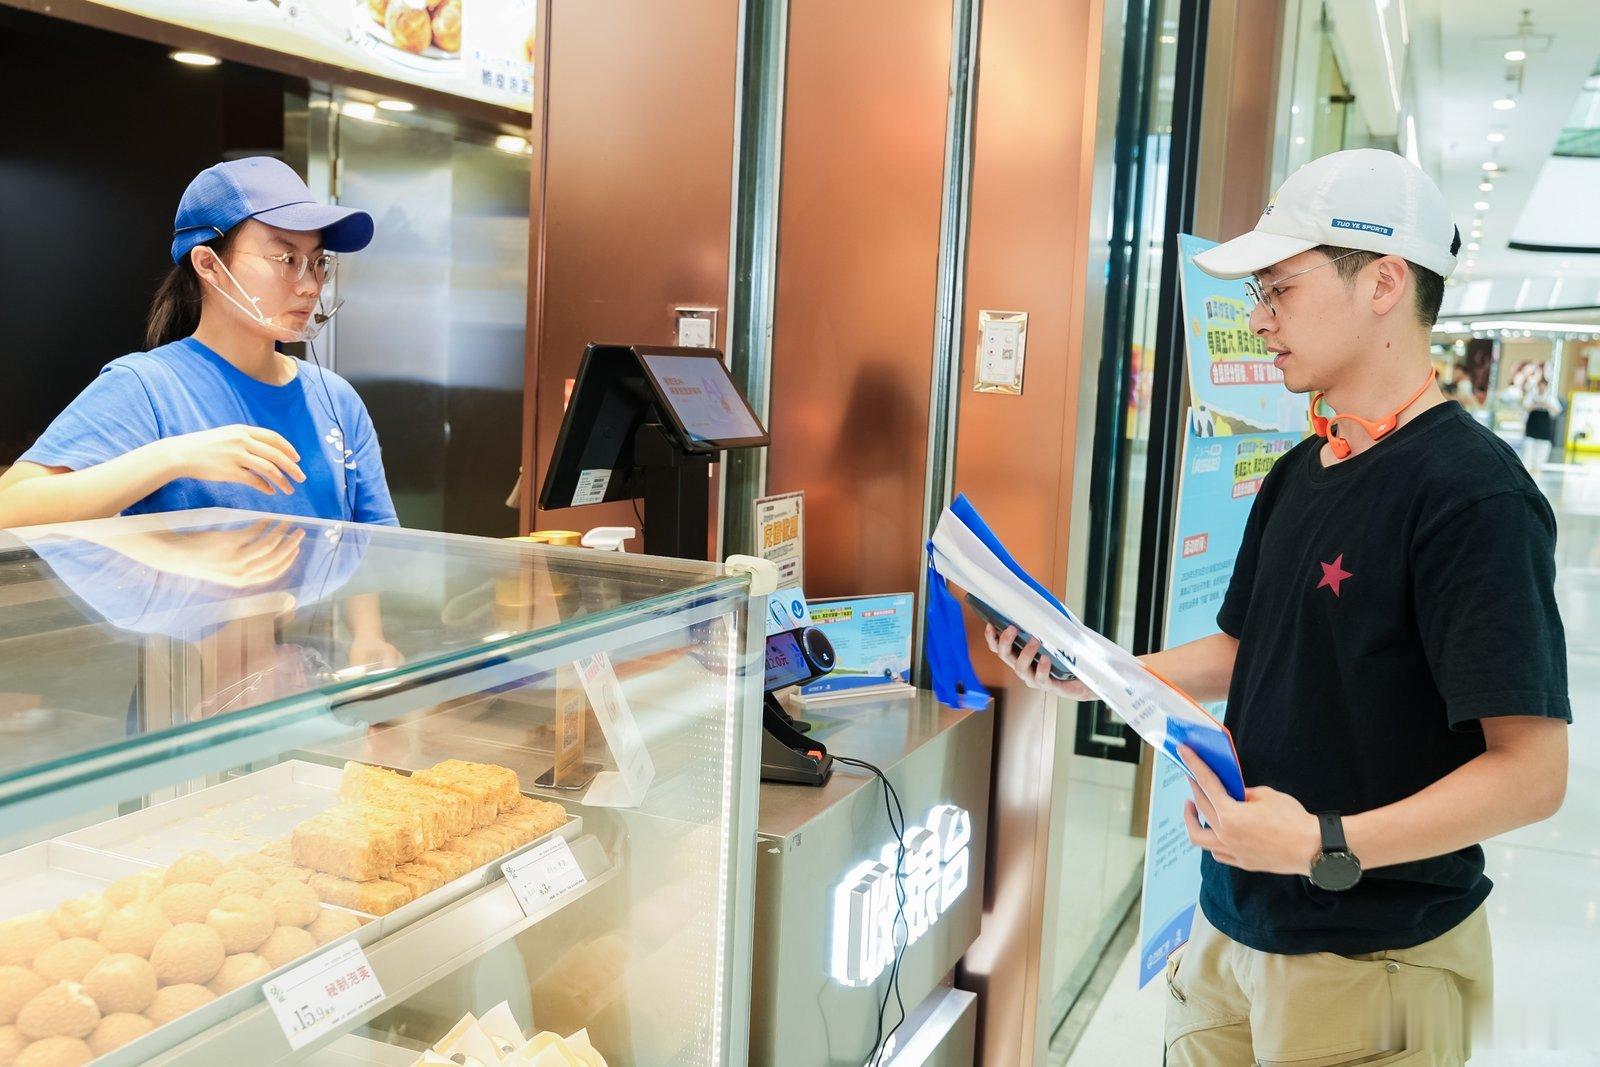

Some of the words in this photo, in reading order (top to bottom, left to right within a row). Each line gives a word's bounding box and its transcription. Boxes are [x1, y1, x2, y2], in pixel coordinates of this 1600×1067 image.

[1361, 223, 1389, 235] SPORTS
[324, 965, 371, 998] 秘制泡芙
